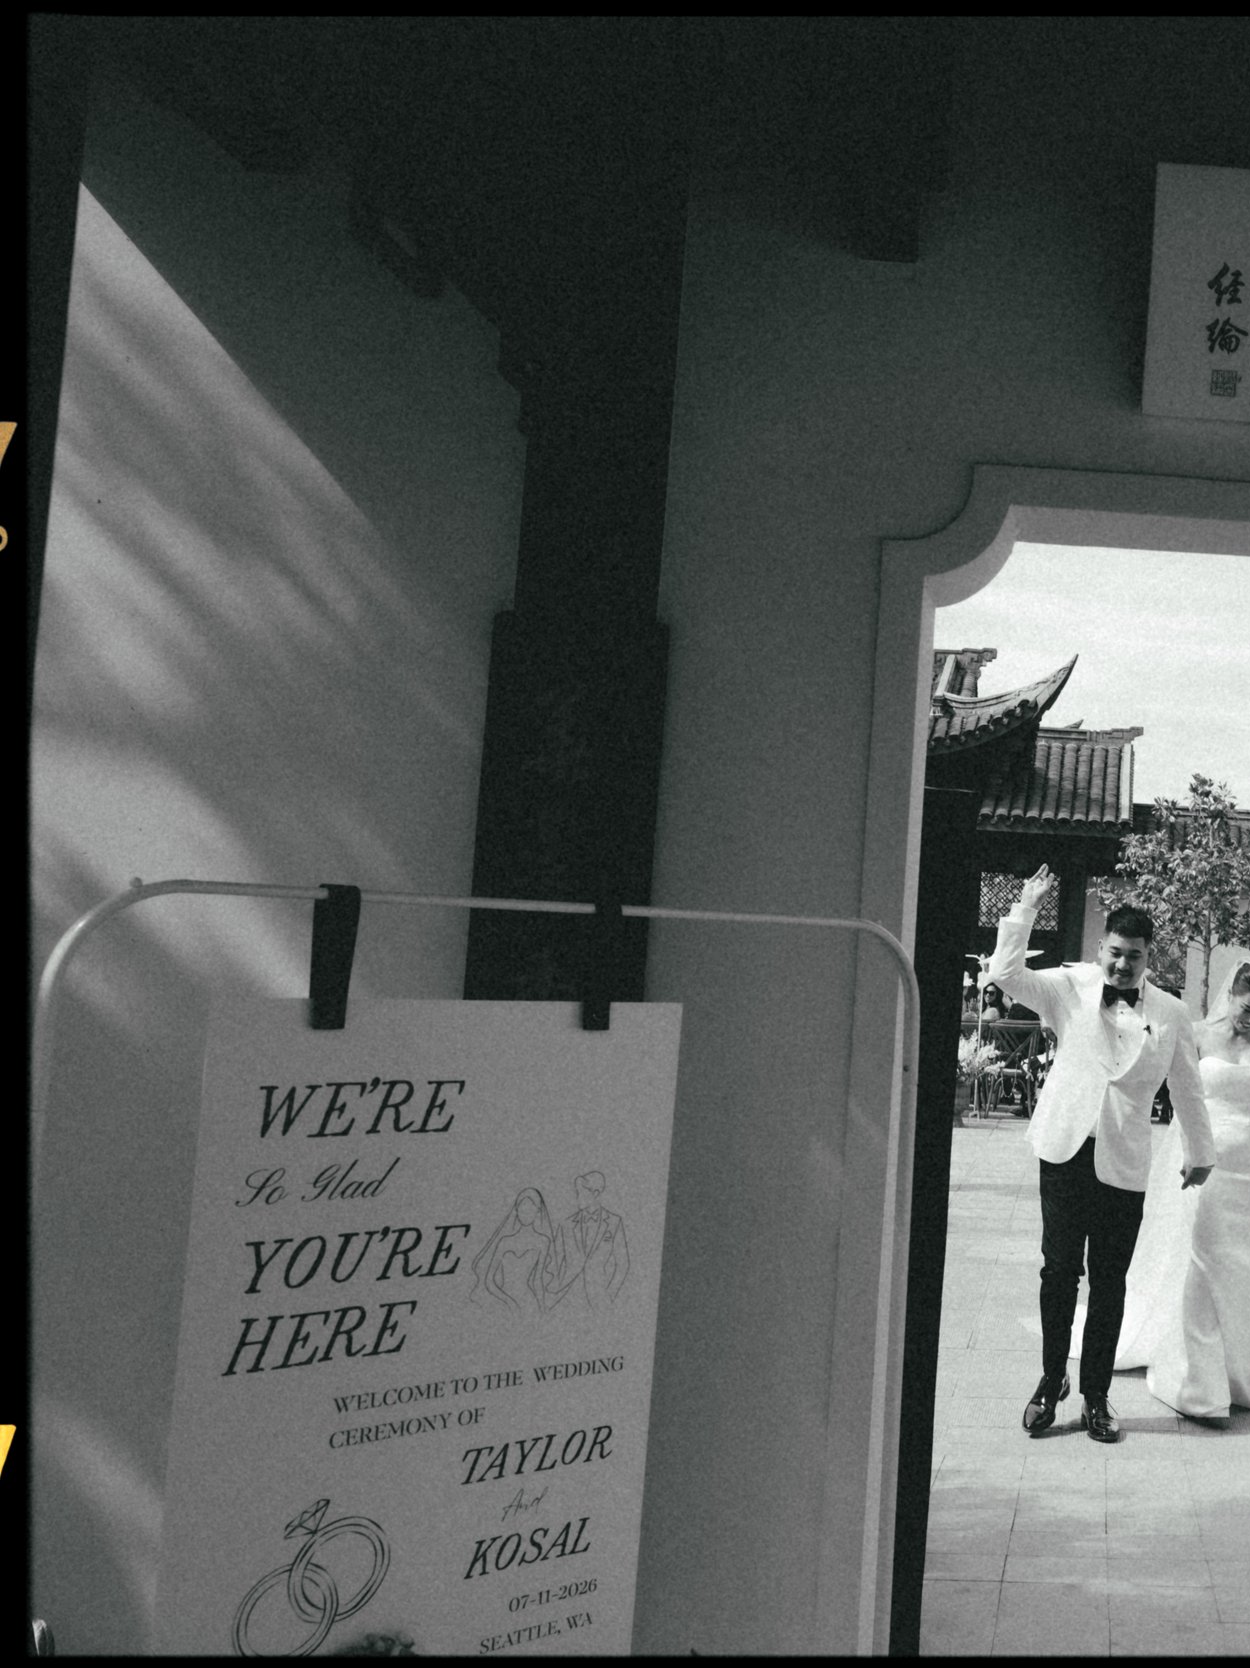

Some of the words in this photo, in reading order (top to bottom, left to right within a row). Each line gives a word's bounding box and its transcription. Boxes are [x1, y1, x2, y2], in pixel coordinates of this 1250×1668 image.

[235, 1168, 288, 1208] So
[301, 1156, 401, 1203] Glad
[221, 1300, 418, 1377] HERE
[334, 1381, 446, 1415] WELCOME
[450, 1376, 479, 1395] TO
[483, 1370, 524, 1390] THE
[532, 1356, 625, 1383] WEDDING
[328, 1411, 452, 1450] CEREMONY
[457, 1407, 486, 1427] OF
[460, 1424, 614, 1486] TAYLOR
[501, 1486, 549, 1523] And
[463, 1516, 592, 1580] KOSAL
[508, 1578, 599, 1613] 07-11-2026
[479, 1619, 561, 1655] SEATTLE,
[566, 1611, 594, 1630] WA
